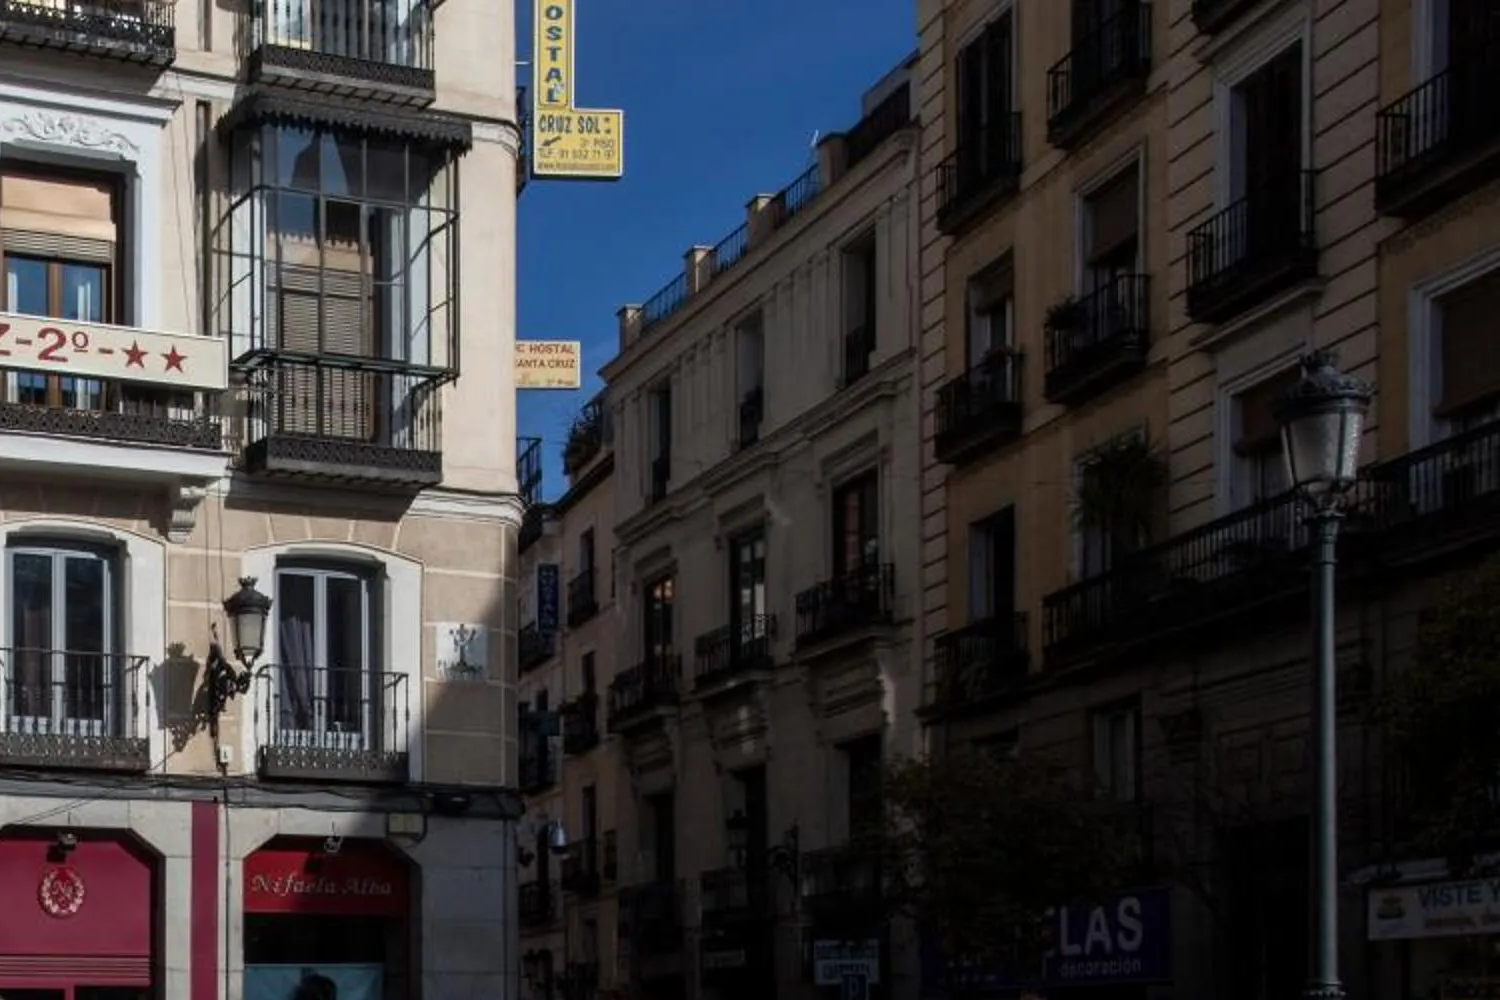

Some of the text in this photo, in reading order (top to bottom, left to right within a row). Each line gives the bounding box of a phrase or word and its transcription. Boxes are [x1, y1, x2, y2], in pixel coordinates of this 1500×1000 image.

[539, 114, 601, 134] CRUZ SOL
[529, 343, 574, 354] HOSTAL
[515, 359, 575, 369] ANTA CRUZ
[342, 876, 393, 896] Alba
[1417, 885, 1482, 908] VISTE
